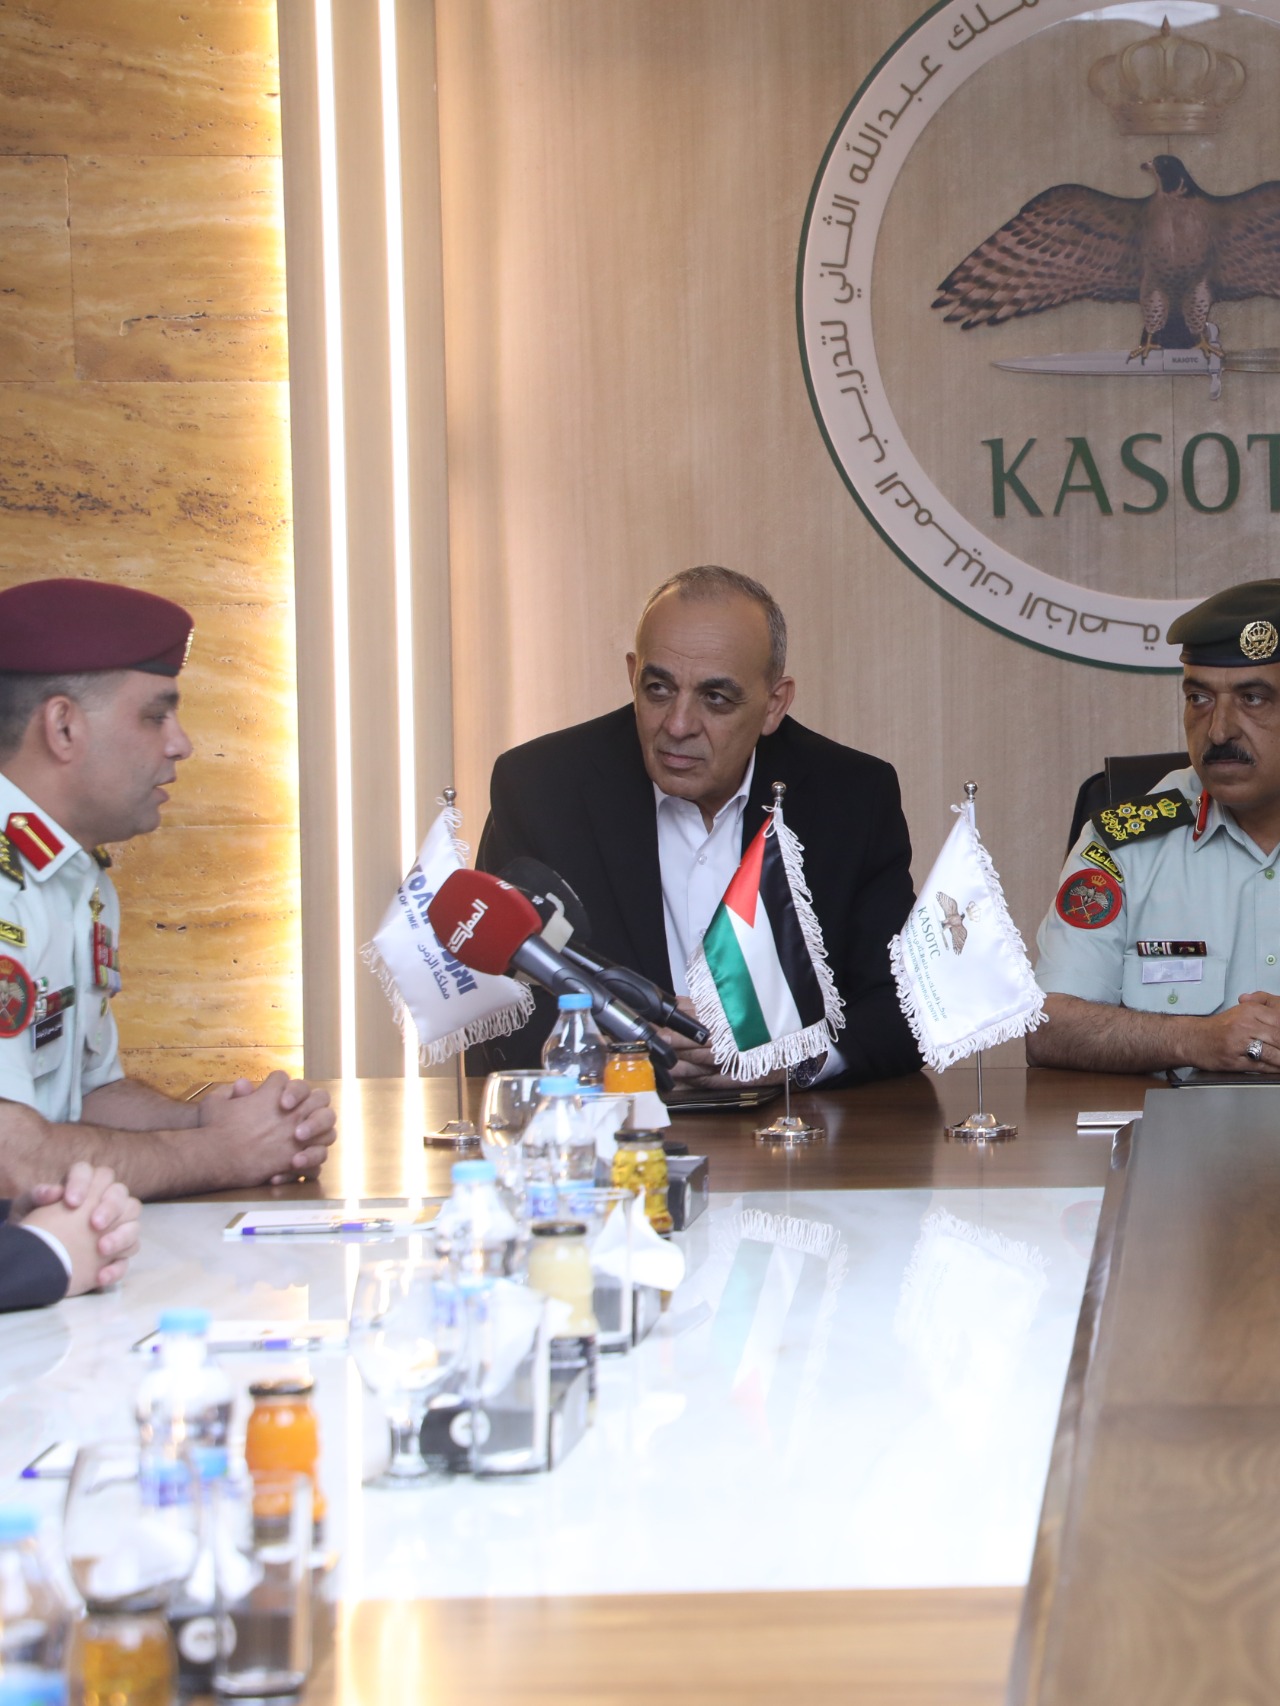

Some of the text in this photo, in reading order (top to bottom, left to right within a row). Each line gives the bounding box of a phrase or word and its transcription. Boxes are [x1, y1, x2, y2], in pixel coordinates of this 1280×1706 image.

[820, 194, 862, 304] الثاني
[820, 320, 888, 463] لتدريب
[875, 472, 1013, 596] العمليات
[1019, 592, 1160, 651] الخاصة
[399, 895, 407, 906] OF
[404, 908, 419, 930] TIME
[917, 906, 941, 960] KASOTC
[417, 943, 439, 970] الزمن
[433, 969, 450, 1000] مملكة
[906, 937, 919, 973] OPERATIONS
[926, 1001, 939, 1022] CENTER
